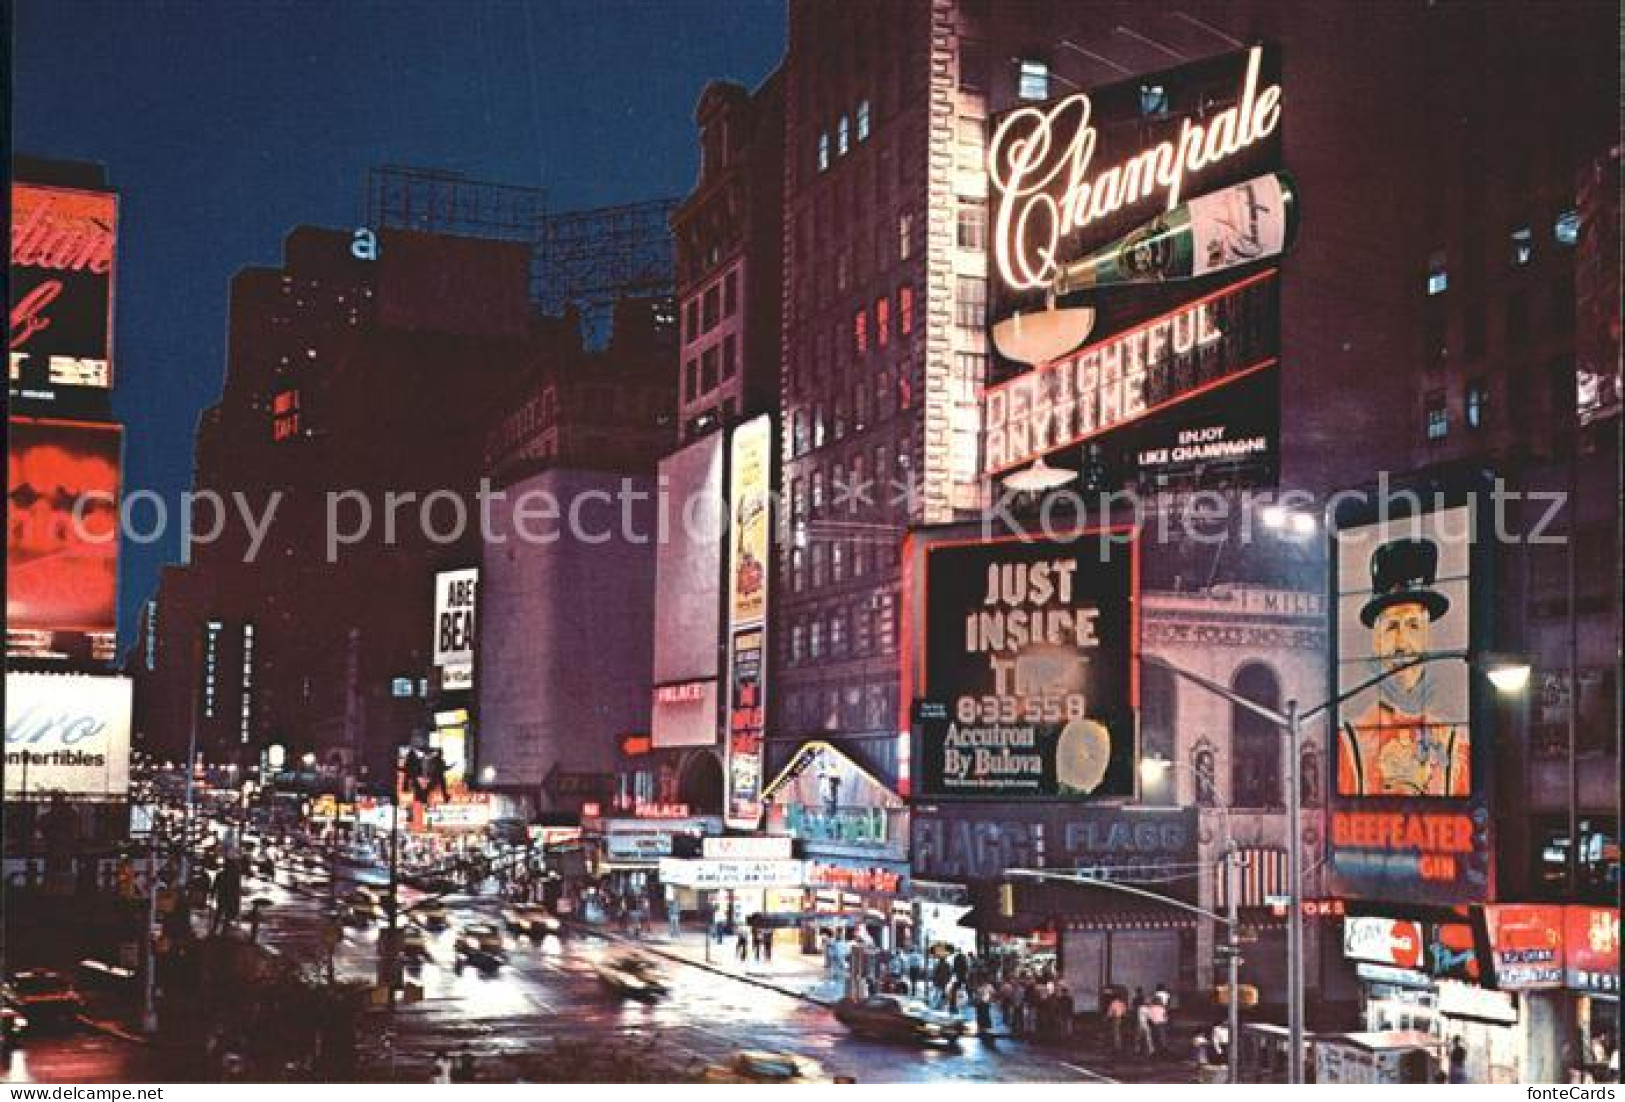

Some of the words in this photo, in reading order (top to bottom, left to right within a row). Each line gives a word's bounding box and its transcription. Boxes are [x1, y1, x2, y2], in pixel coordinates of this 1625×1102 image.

[990, 46, 1281, 289] Champale
[986, 303, 1222, 426] DELIGHTFUL
[986, 371, 1150, 473] ANYTIME
[1179, 426, 1226, 444] ENJOY
[1138, 451, 1168, 466] LIKE
[448, 577, 475, 608] ABE
[984, 557, 1078, 607] JUST
[945, 722, 1035, 748] Accutron
[944, 748, 973, 778] By
[974, 747, 1042, 775] Bulova
[1334, 811, 1475, 852] BEEFEATER
[1419, 853, 1457, 881] GIN
